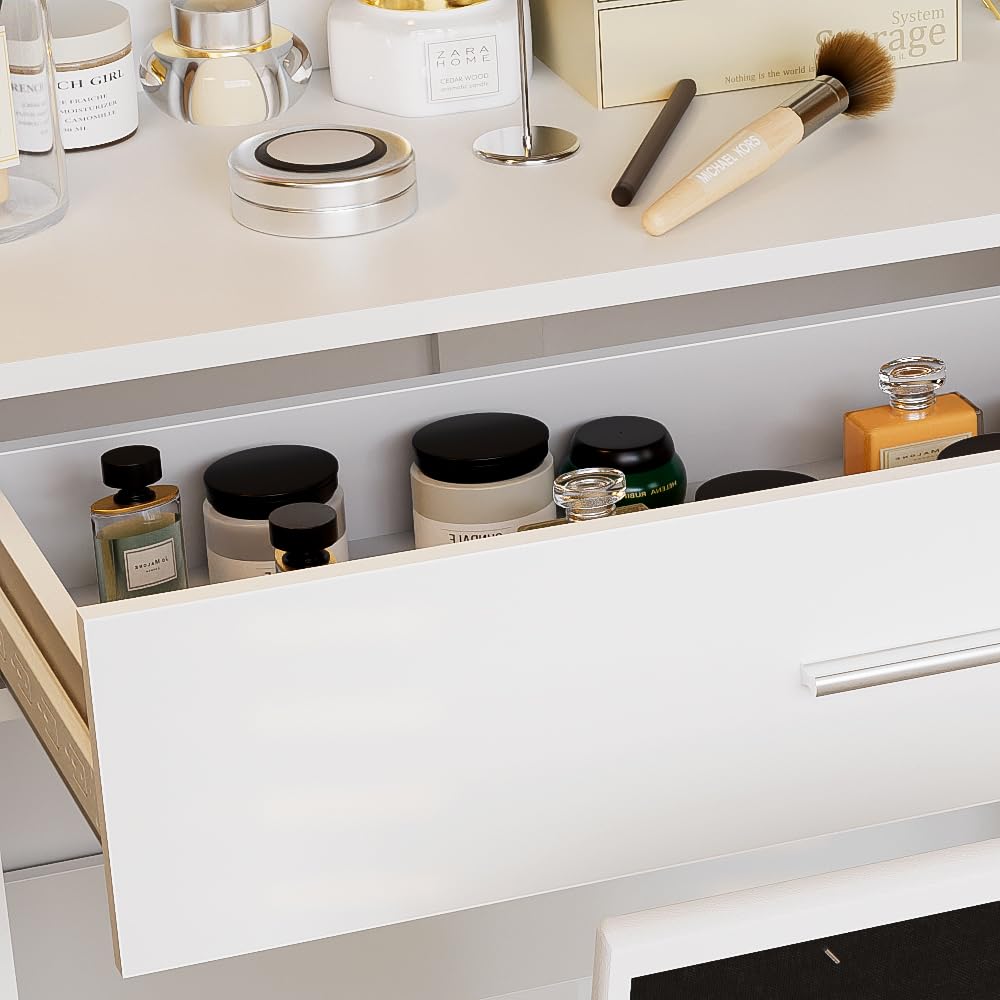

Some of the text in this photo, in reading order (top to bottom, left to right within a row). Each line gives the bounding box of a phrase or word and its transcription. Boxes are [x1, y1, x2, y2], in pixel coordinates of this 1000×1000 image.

[892, 8, 945, 27] System
[816, 22, 946, 57] Srage
[436, 45, 489, 59] ZARA
[436, 54, 491, 68] HOME
[90, 69, 124, 86] GIRL
[440, 72, 489, 85] CEDAR WOOD
[725, 73, 756, 84] Nothing
[758, 71, 765, 80] is
[768, 69, 781, 78] the
[783, 66, 806, 76] world
[695, 135, 761, 185] MICHAEL KORS
